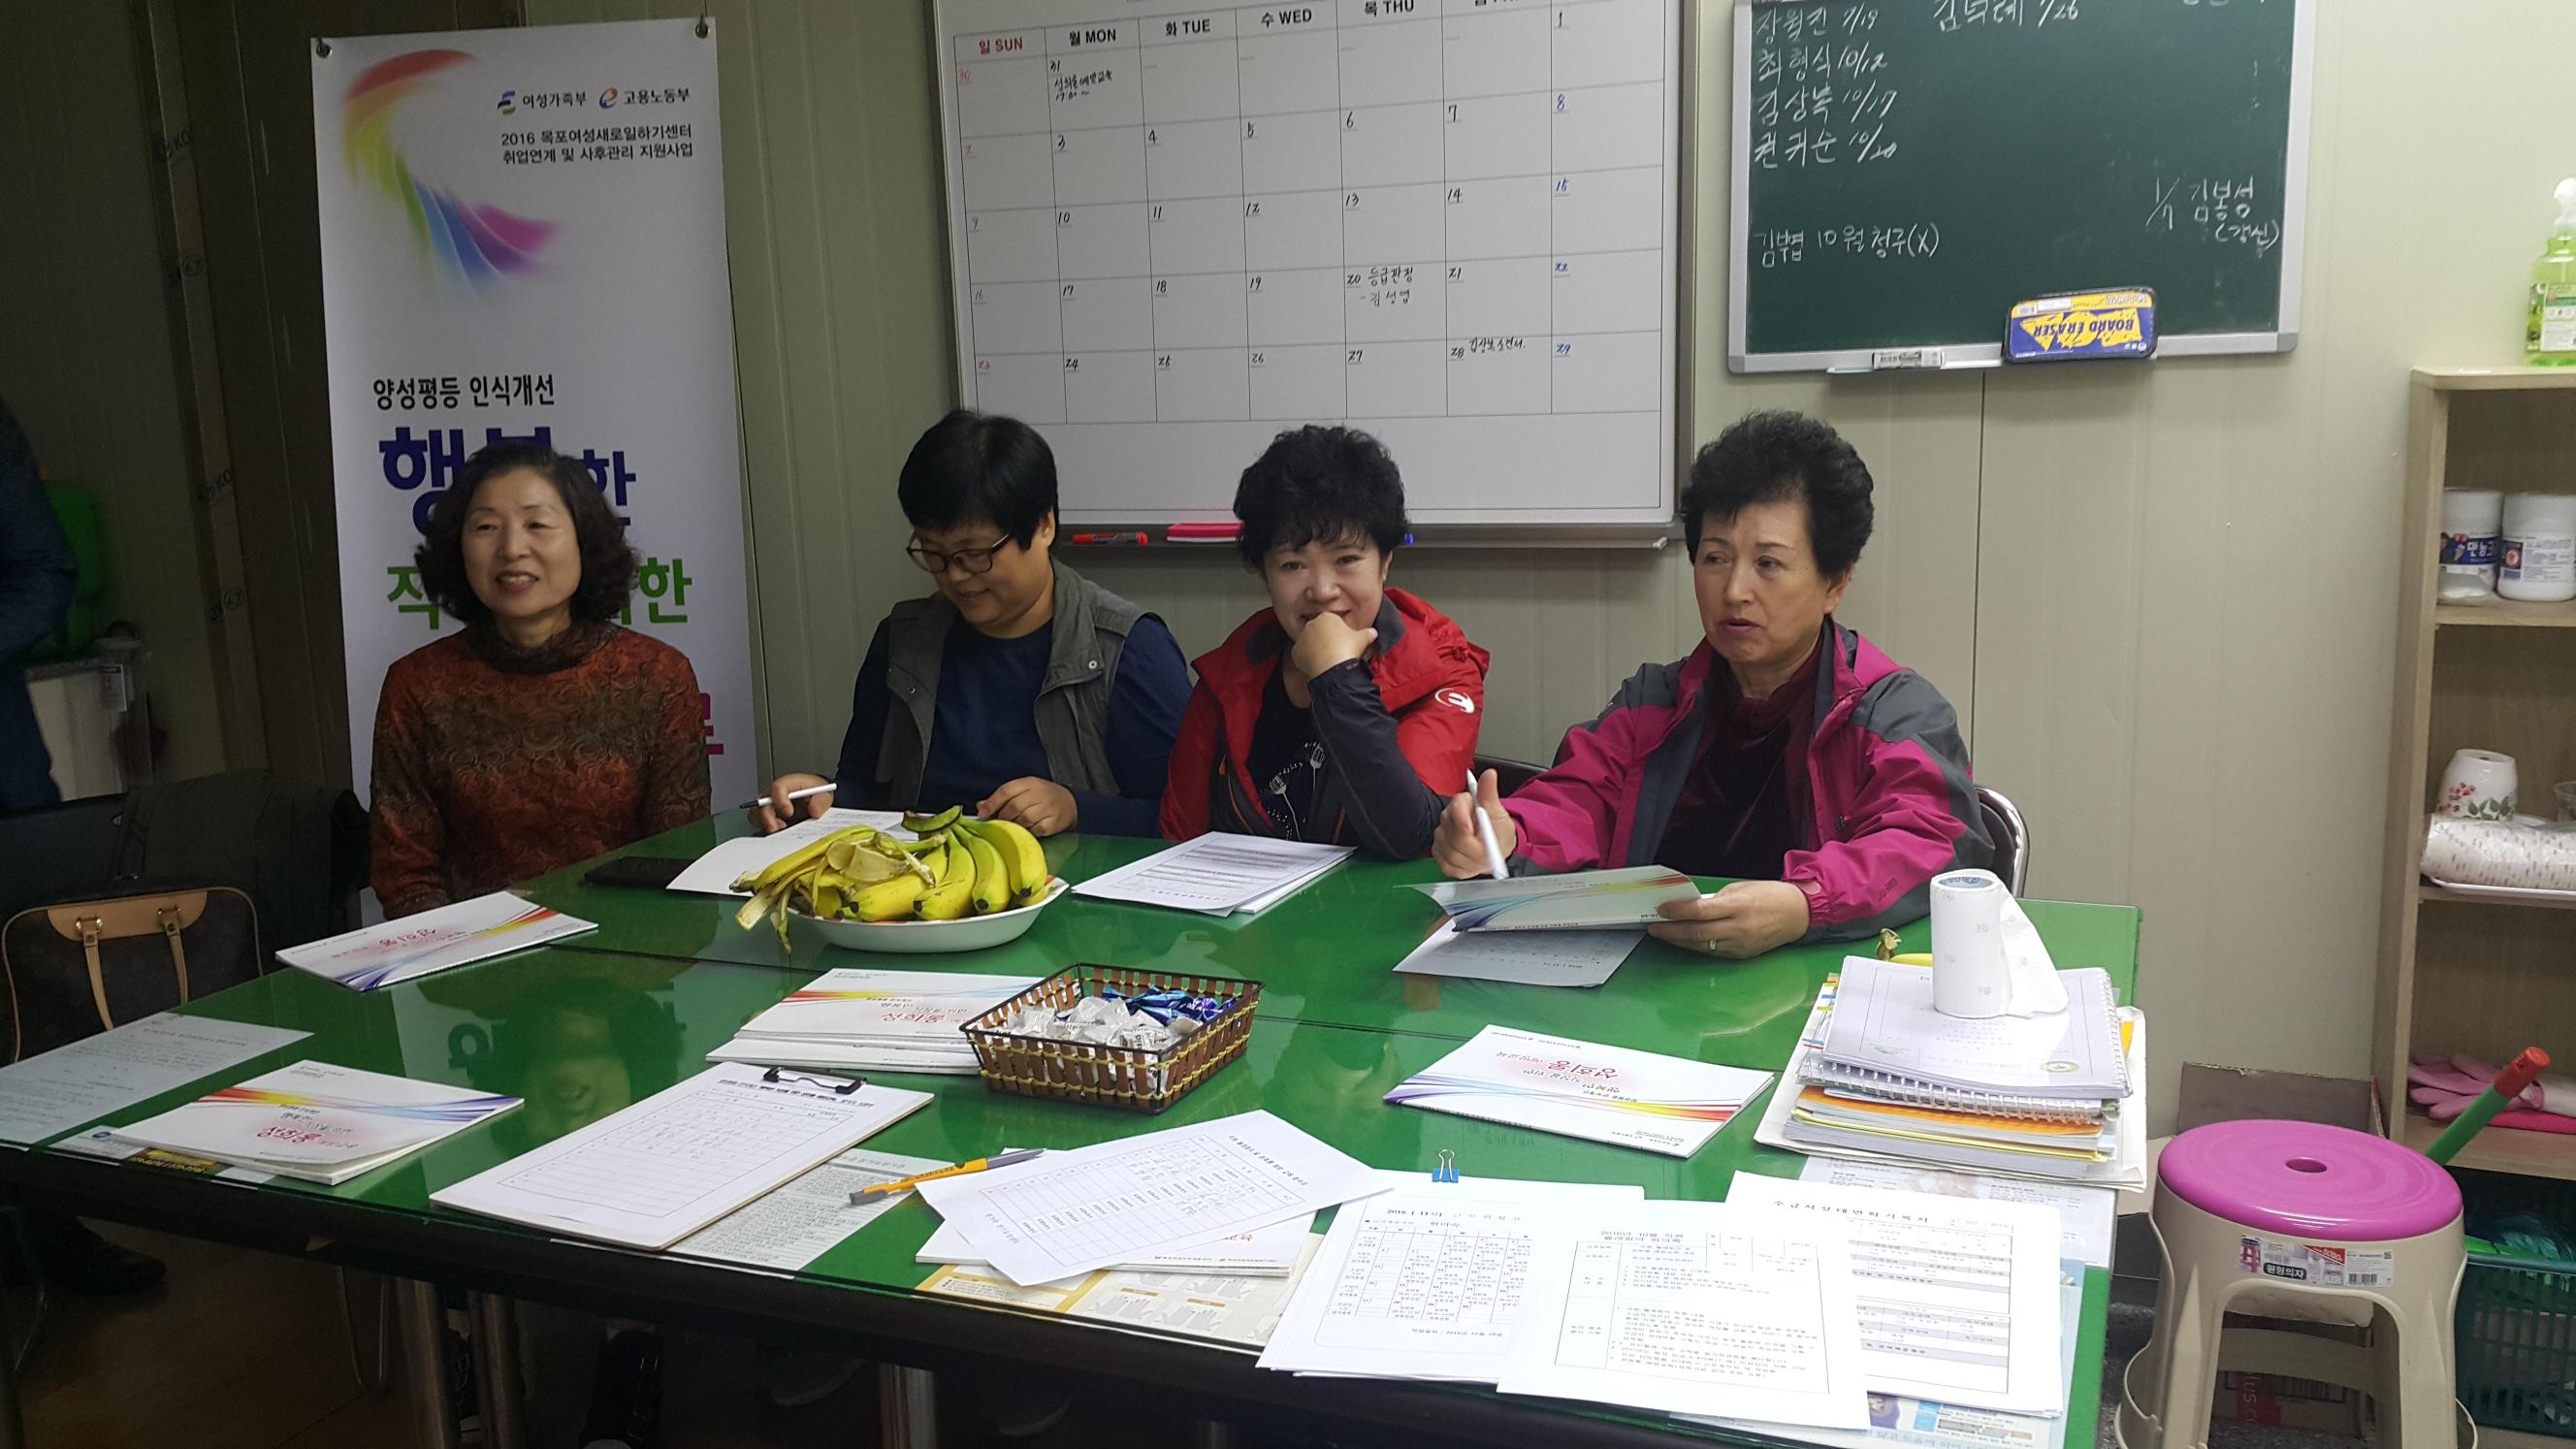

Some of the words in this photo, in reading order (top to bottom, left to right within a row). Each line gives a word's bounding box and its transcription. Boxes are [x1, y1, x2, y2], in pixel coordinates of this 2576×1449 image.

[1383, 0, 1414, 14] THU
[1261, 13, 1273, 27] 수
[1279, 10, 1311, 24] WED
[1166, 23, 1177, 36] 화
[1183, 19, 1210, 34] TUE
[979, 41, 990, 54] 일
[995, 38, 1023, 51] SUN
[1069, 33, 1080, 47] 월
[1085, 29, 1116, 44] MON
[523, 91, 587, 109] 여성가족부
[624, 87, 691, 105] 고용노동부
[1346, 111, 1354, 128] 6
[1447, 104, 1458, 122] 7
[501, 133, 535, 146] 2016
[541, 123, 692, 145] 목포여성새로일하기센터
[503, 149, 557, 165] 취업연계
[562, 147, 574, 162] 및
[581, 145, 633, 161] 사후관리
[640, 143, 692, 158] 지원사업
[1345, 194, 1359, 208] 13
[1447, 188, 1463, 203] 14
[1057, 211, 1070, 225] 10
[1153, 206, 1163, 219] 11
[1156, 280, 1167, 293] 18
[1249, 277, 1261, 290] 19
[2034, 321, 2085, 338] ERASER
[2089, 317, 2134, 332] BOARD
[373, 375, 461, 410] 양성평등
[469, 374, 555, 406] 인식개선
[379, 427, 636, 536] 행한
[1547, 1059, 1619, 1080] 성희롱
[2266, 1263, 2305, 1280] 원형의자
